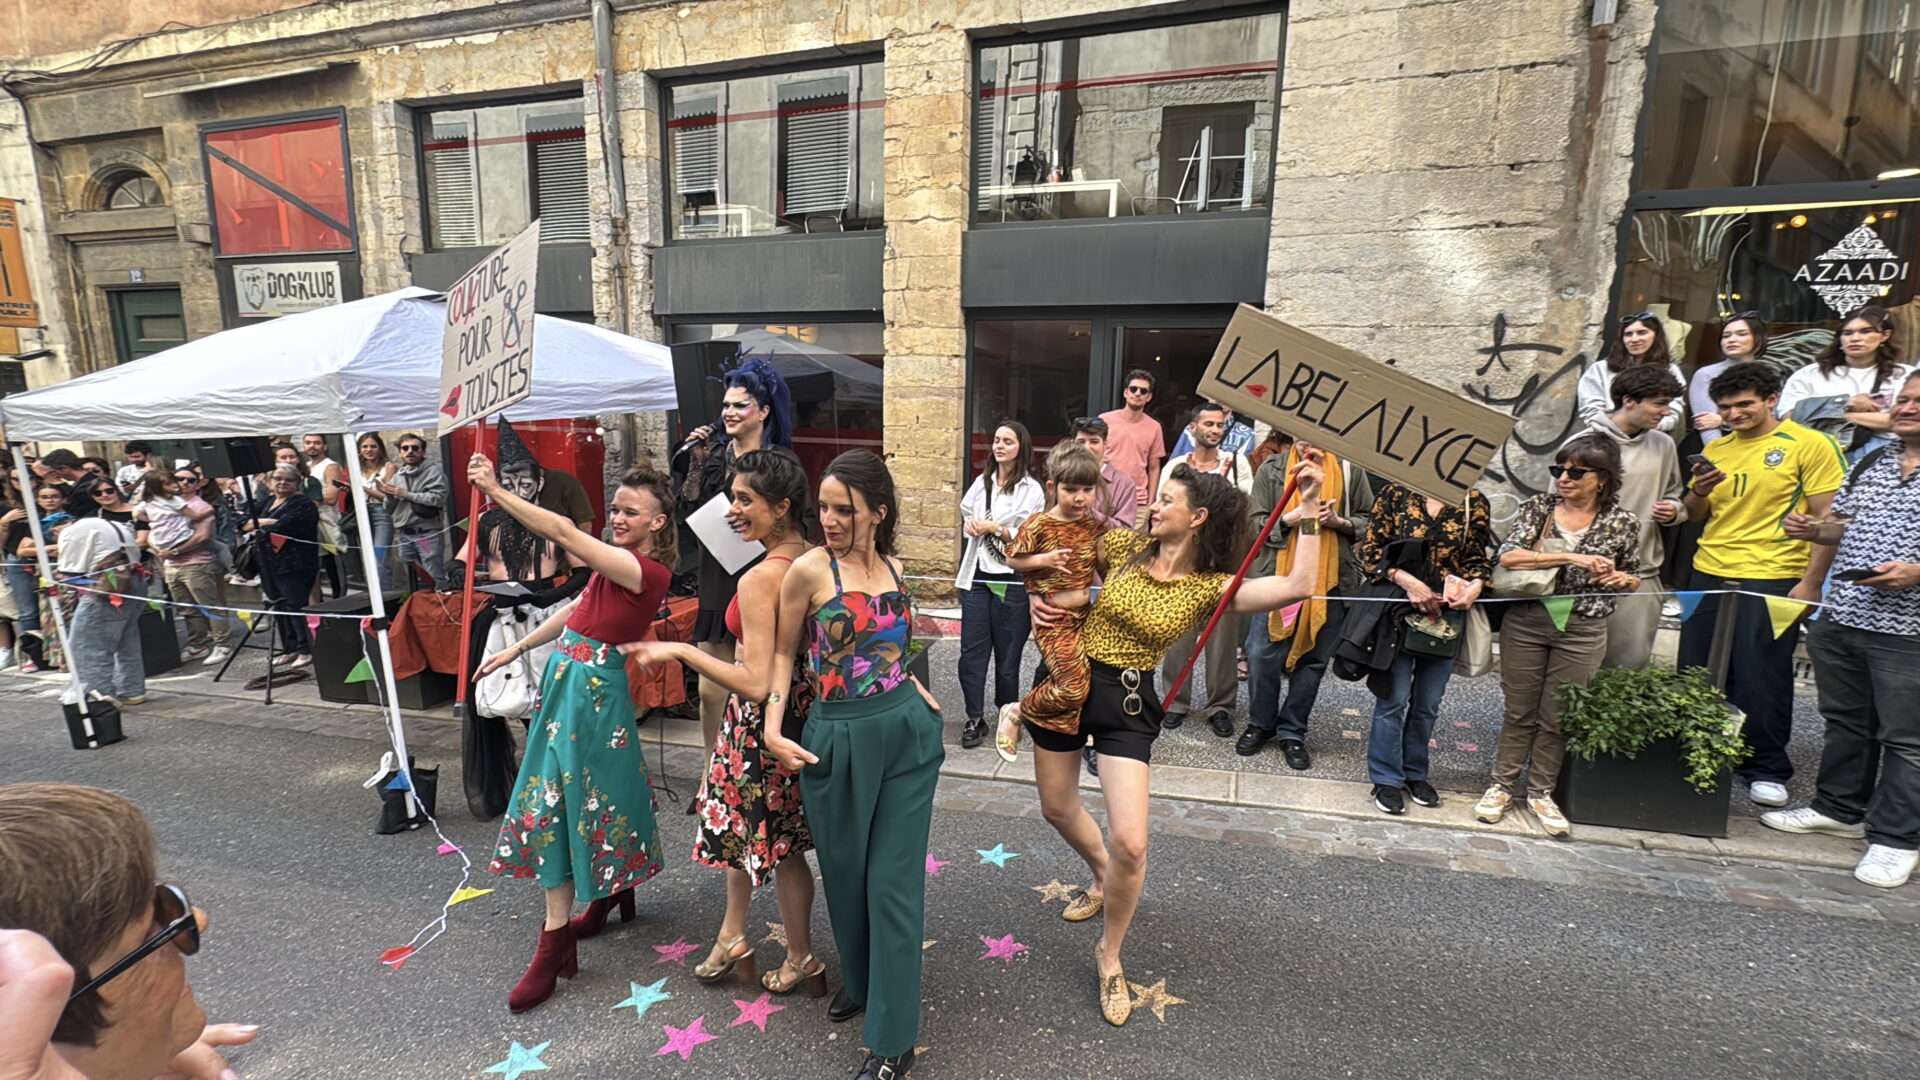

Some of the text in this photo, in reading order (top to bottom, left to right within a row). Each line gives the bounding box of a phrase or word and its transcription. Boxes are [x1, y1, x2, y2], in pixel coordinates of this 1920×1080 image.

[1792, 262, 1909, 282] AZAADI
[458, 315, 492, 372] POUR
[1732, 473, 1748, 498] 11
